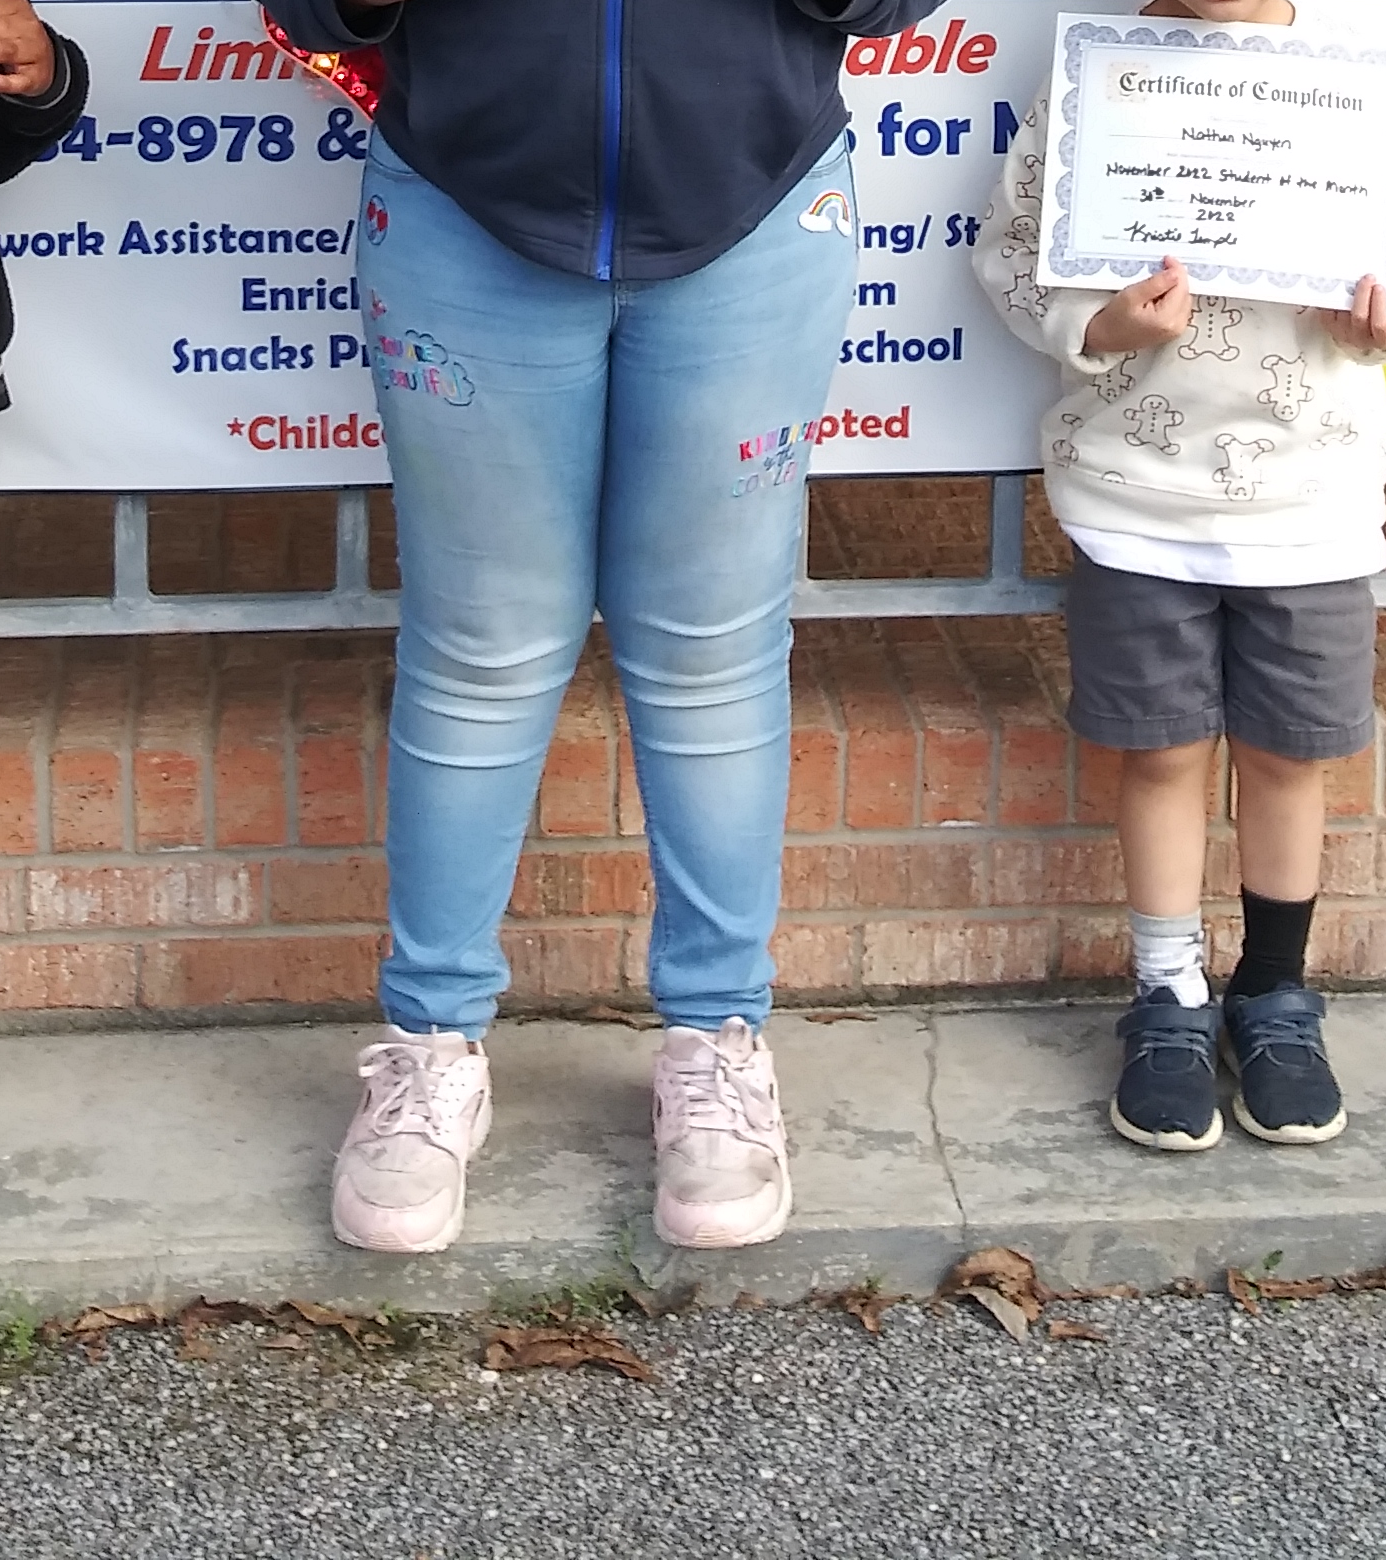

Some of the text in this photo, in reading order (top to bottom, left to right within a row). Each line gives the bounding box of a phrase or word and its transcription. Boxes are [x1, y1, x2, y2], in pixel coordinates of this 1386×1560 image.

[1118, 71, 1364, 112] Certificate of Completion
[36, 114, 296, 163] 4-8978
[878, 101, 971, 156] for
[1106, 162, 1172, 178] November
[1175, 165, 1213, 179] 2022
[1219, 168, 1272, 184] Student
[1189, 193, 1256, 208] November
[118, 219, 356, 256] Assistance/
[172, 334, 314, 374] Snacks
[839, 327, 963, 363] school
[227, 412, 387, 451] Childc
